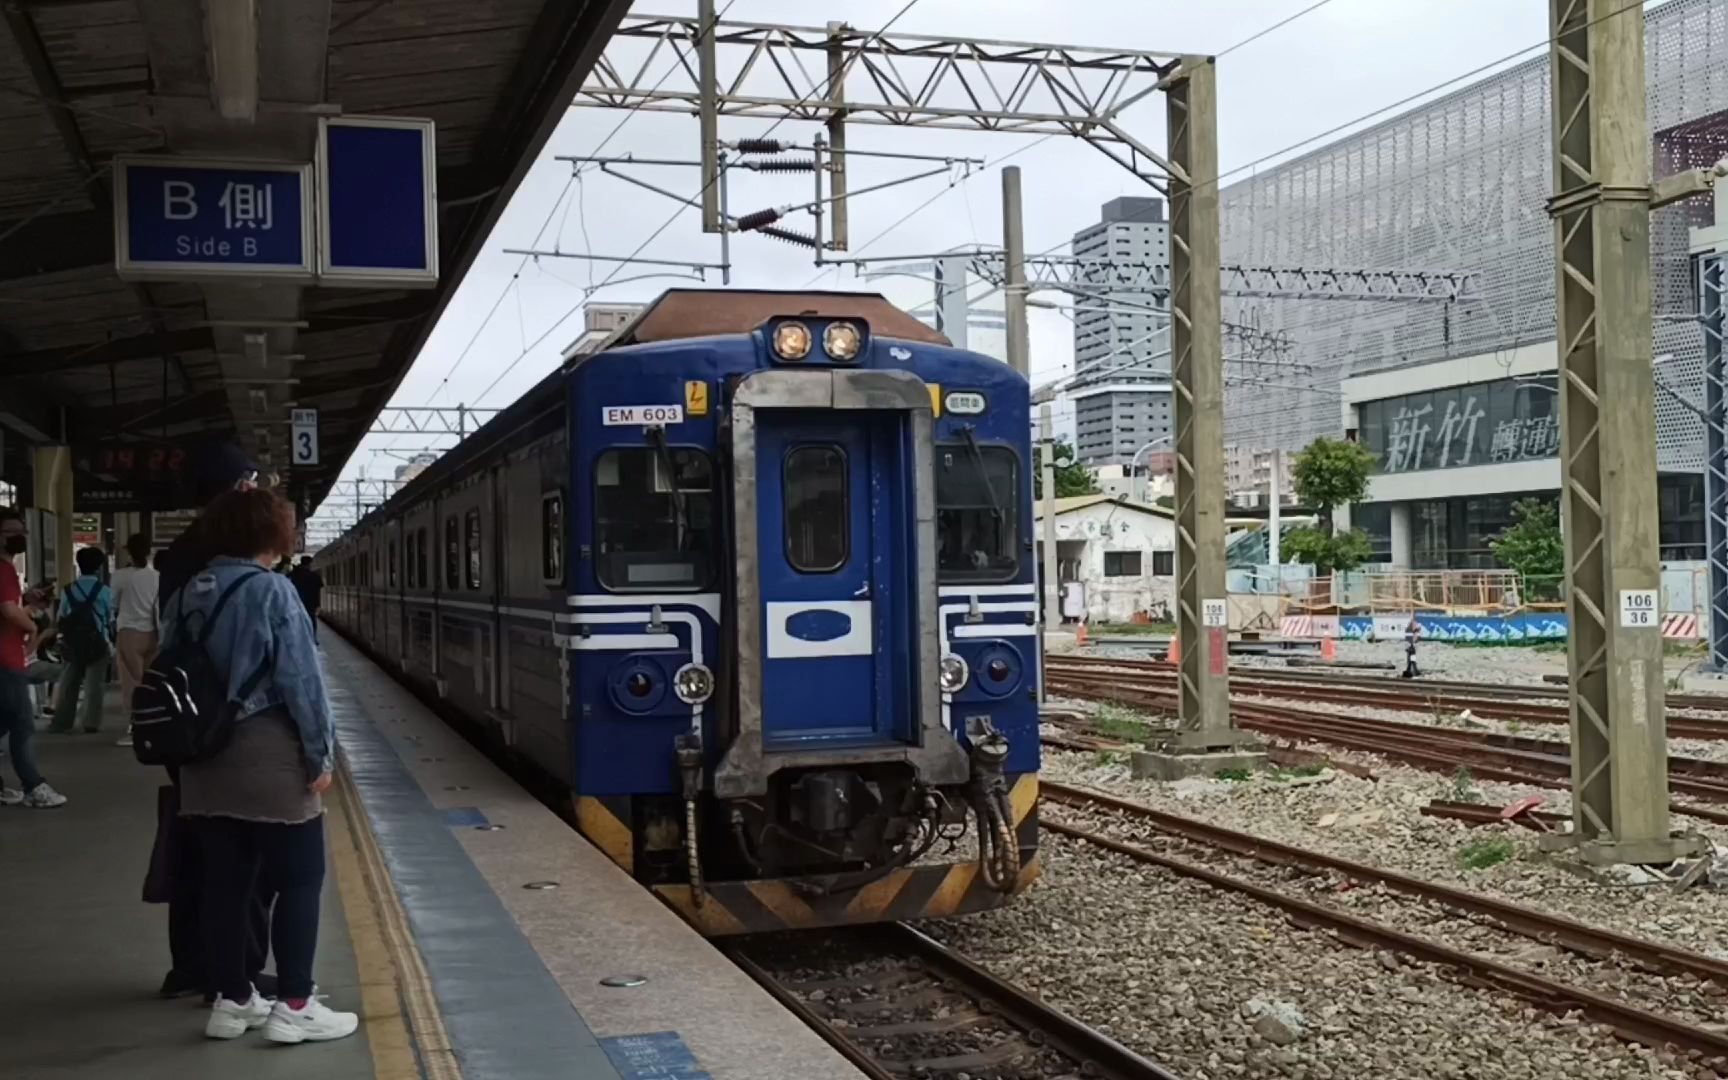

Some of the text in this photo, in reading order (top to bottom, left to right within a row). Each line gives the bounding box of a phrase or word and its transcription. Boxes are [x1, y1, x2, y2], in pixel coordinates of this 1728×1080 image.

[163, 181, 273, 230] B 側
[176, 235, 258, 256] Side B
[608, 408, 678, 422] EM 603
[298, 432, 312, 460] 3
[1626, 594, 1652, 607] 106
[1630, 612, 1648, 624] 36
